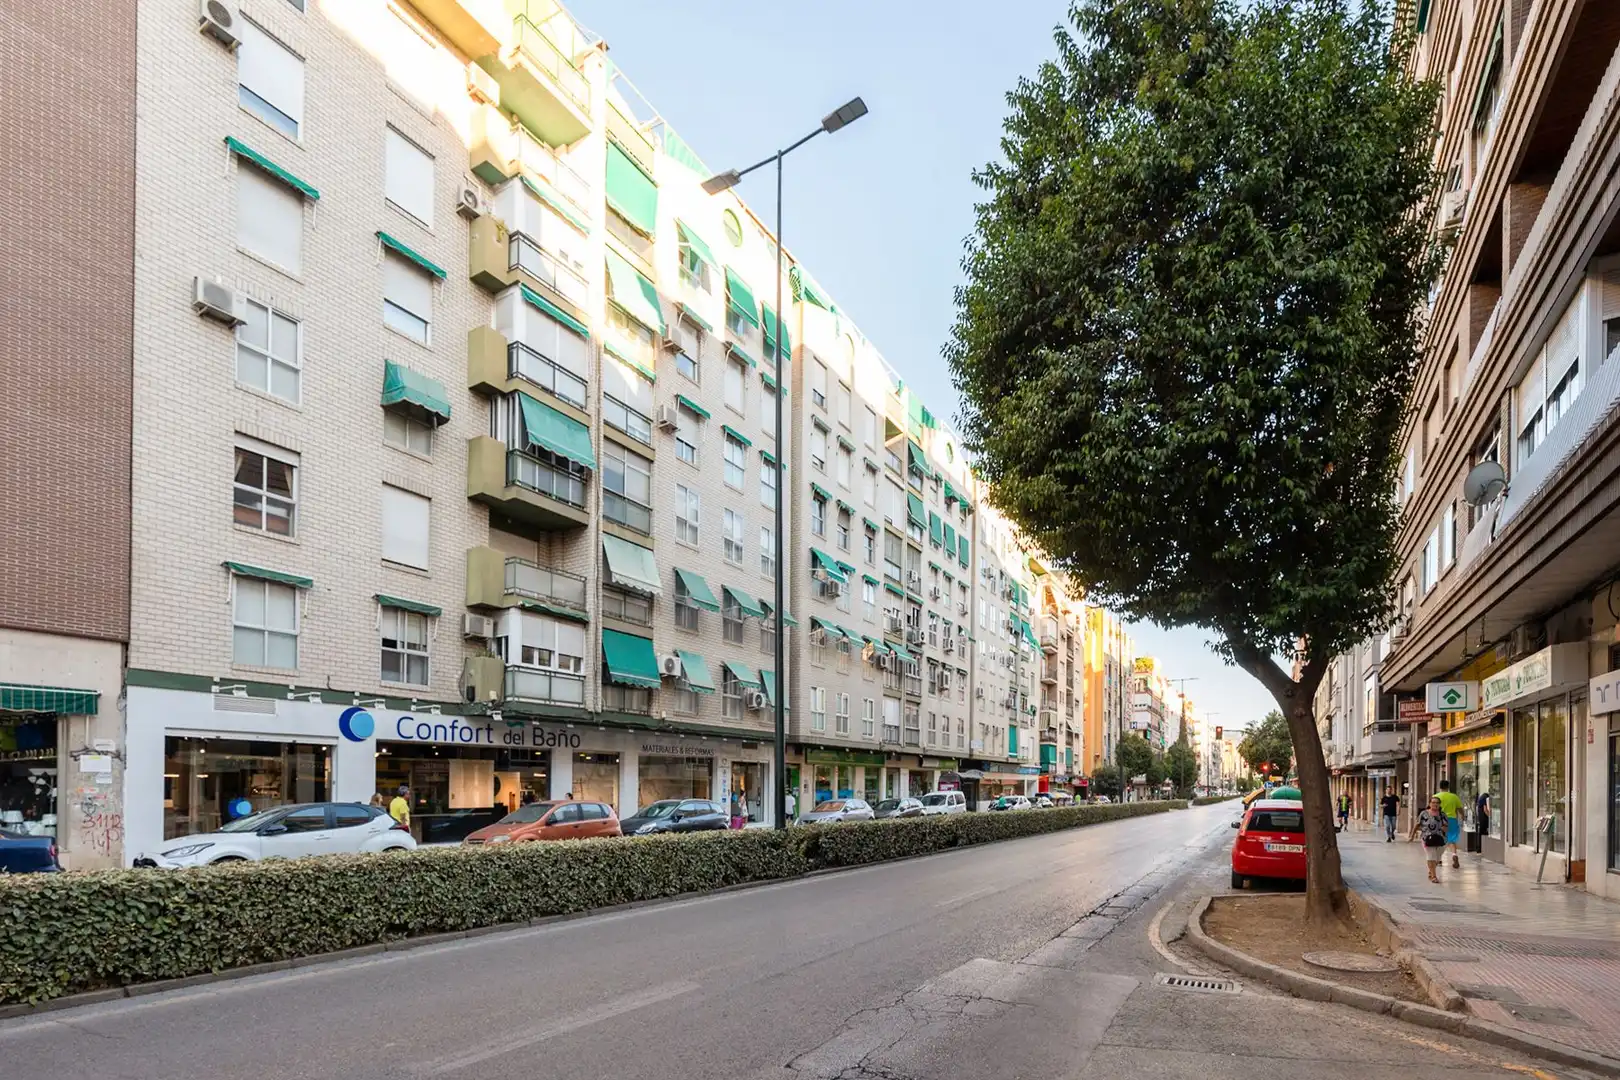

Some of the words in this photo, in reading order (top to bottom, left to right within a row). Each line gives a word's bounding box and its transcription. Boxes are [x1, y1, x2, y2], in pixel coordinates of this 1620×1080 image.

[396, 716, 494, 744] Confort
[503, 729, 524, 745] del
[532, 727, 581, 748] Baño
[642, 745, 679, 754] MATERIALES
[685, 747, 715, 756] REFORMAS
